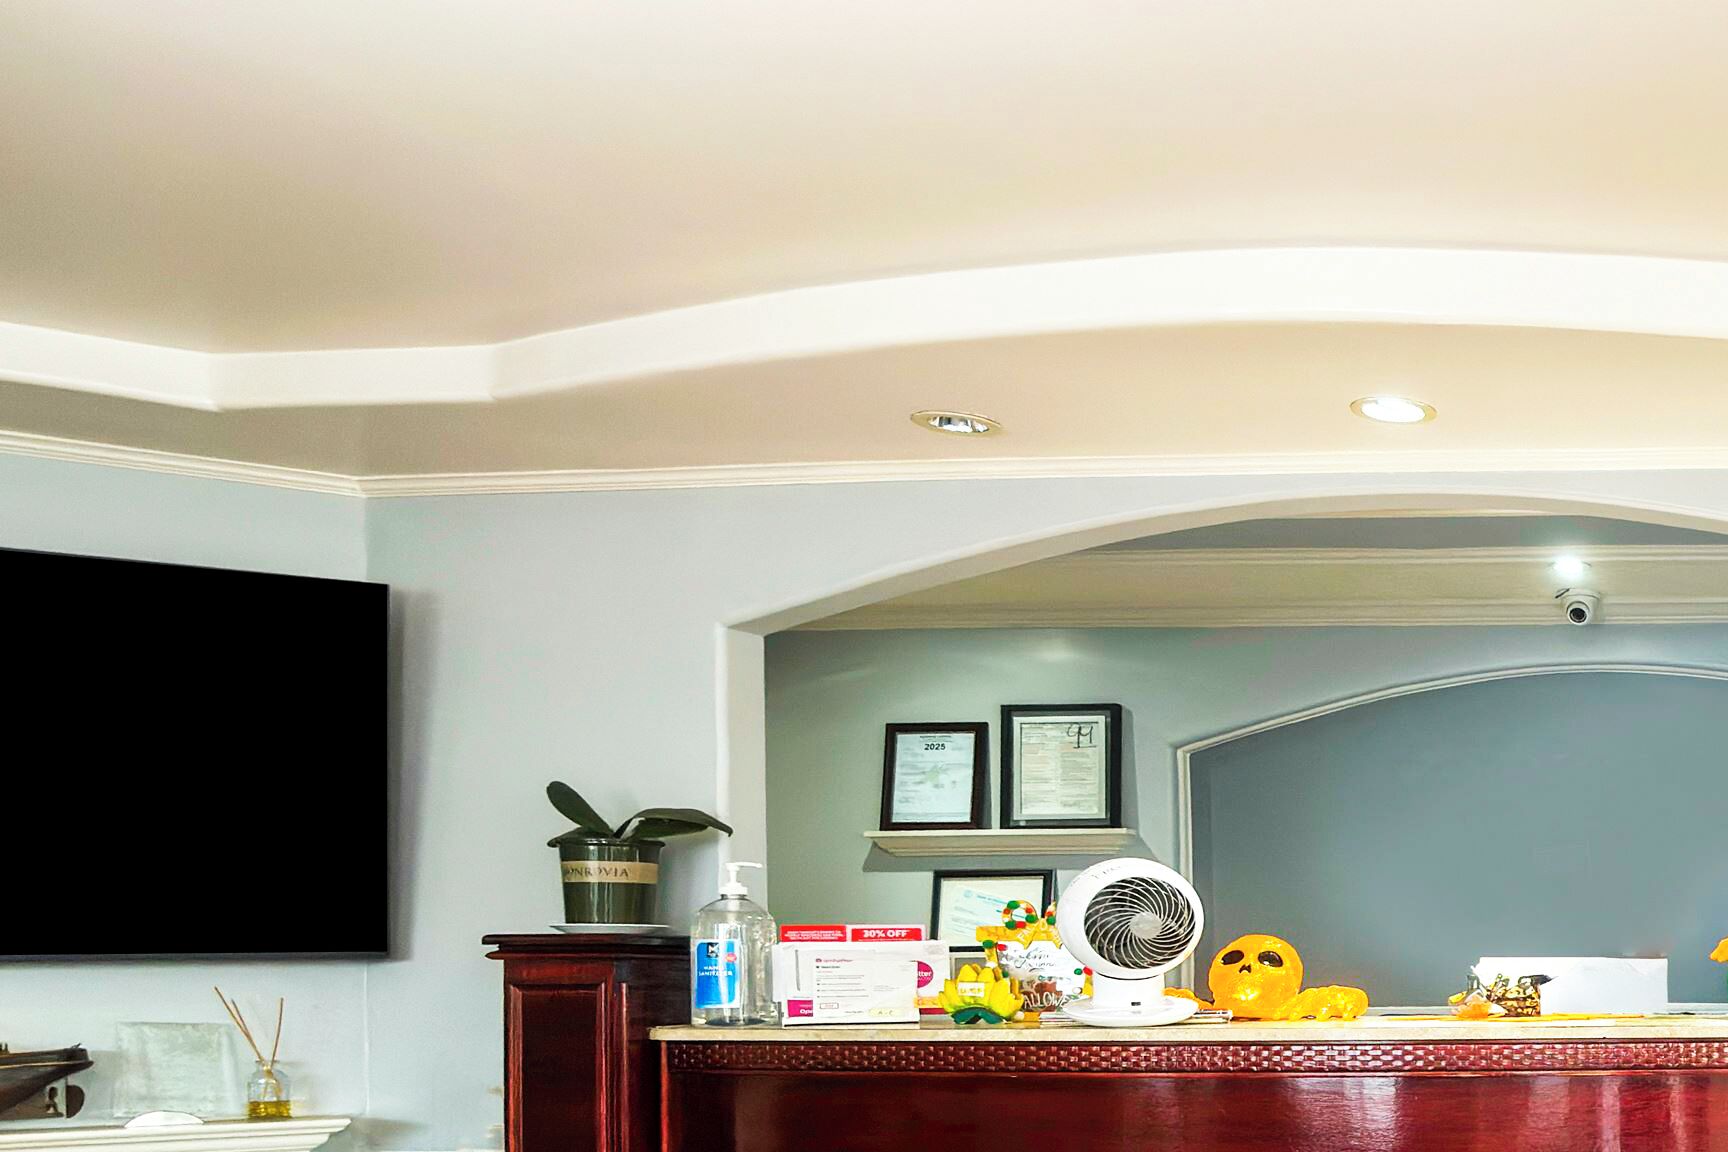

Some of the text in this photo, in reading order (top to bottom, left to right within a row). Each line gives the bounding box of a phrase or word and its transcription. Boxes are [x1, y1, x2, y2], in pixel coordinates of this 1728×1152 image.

[924, 743, 946, 751] 2025
[863, 929, 907, 938] 30% OFF
